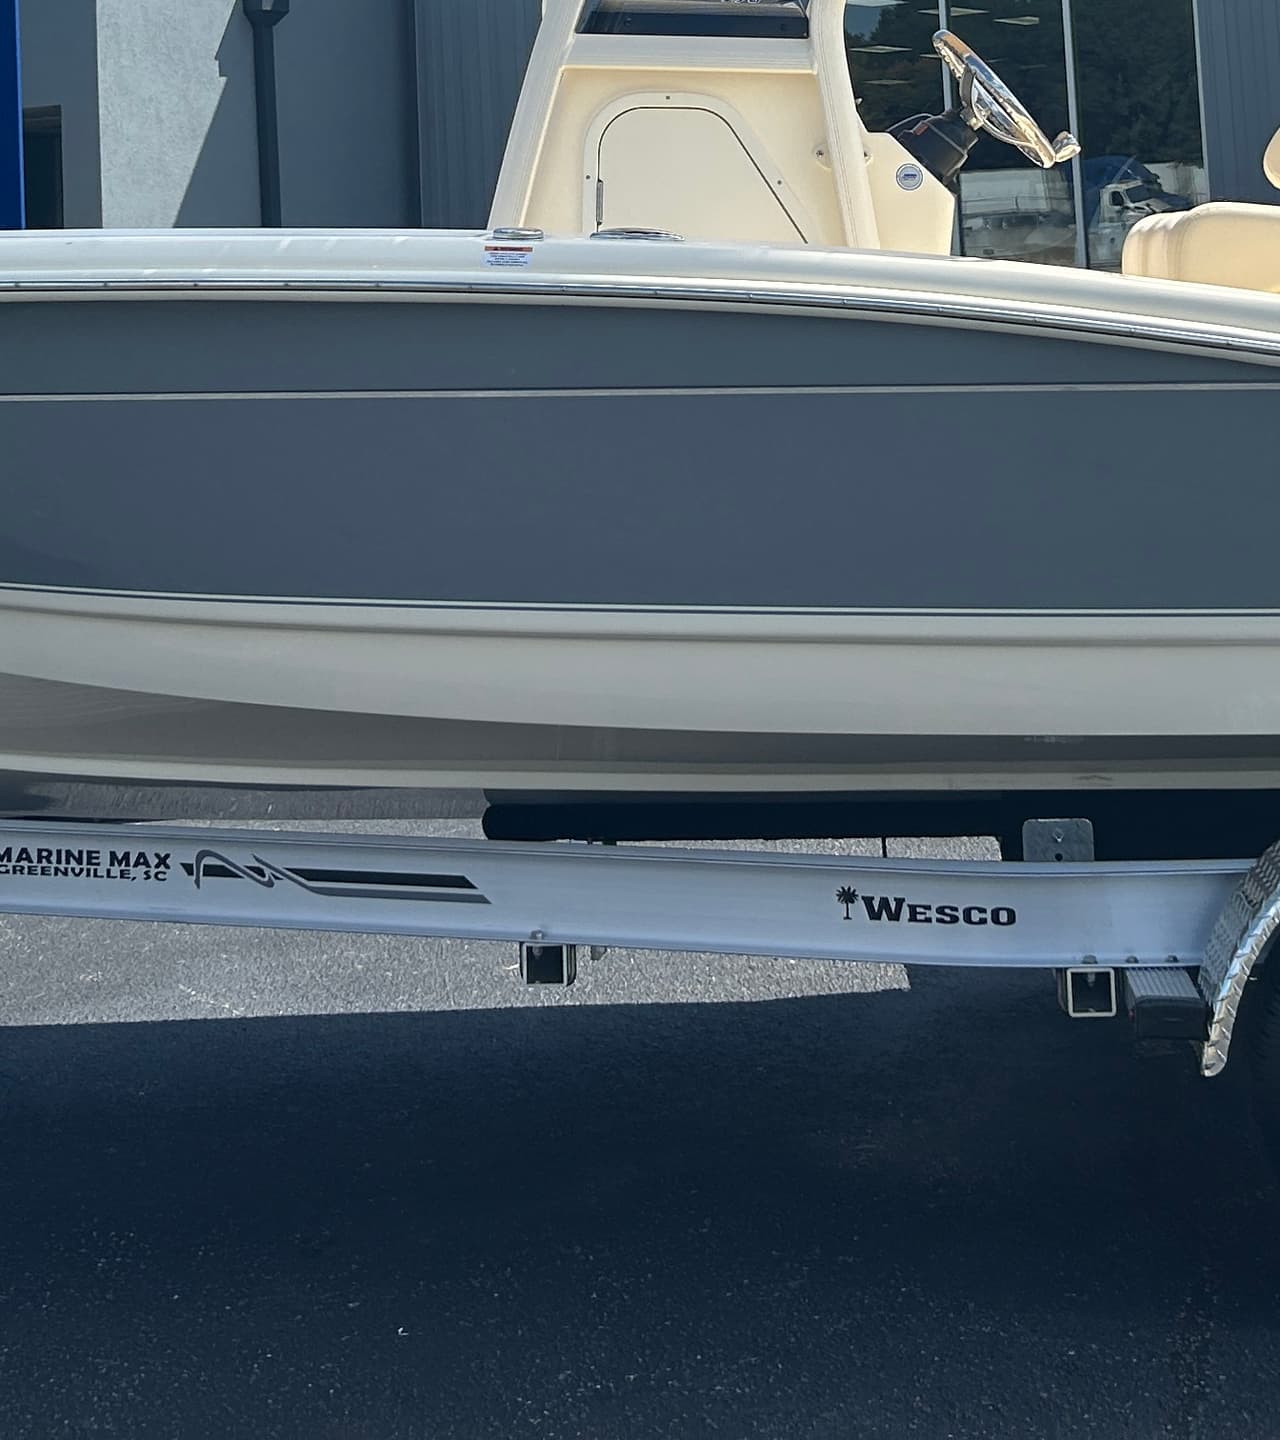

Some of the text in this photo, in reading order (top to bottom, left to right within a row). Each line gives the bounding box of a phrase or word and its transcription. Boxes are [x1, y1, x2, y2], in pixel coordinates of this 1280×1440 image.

[109, 850, 171, 870] MAX
[144, 870, 167, 882] SC
[861, 895, 1017, 926] WESCO
